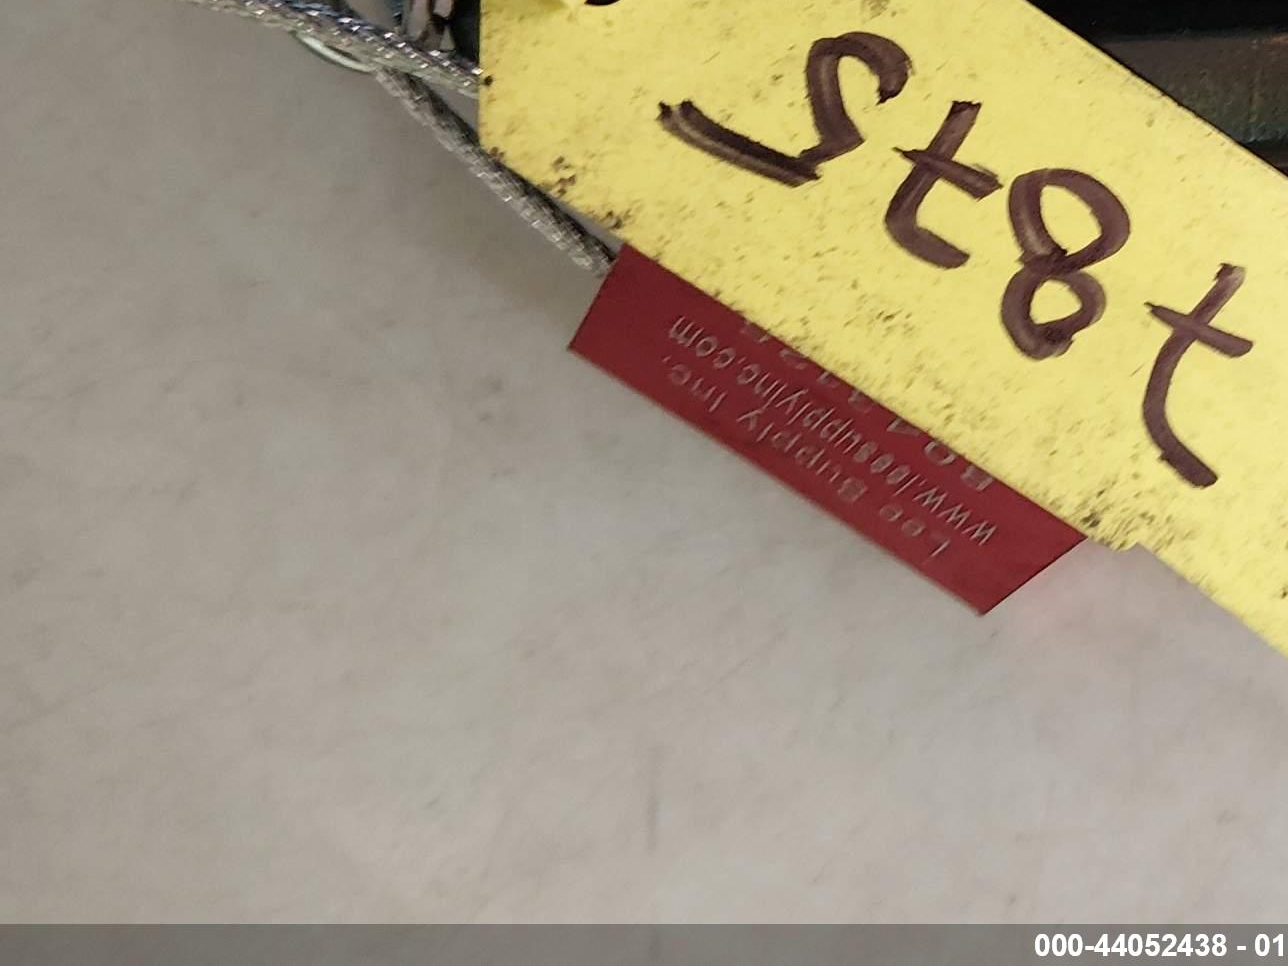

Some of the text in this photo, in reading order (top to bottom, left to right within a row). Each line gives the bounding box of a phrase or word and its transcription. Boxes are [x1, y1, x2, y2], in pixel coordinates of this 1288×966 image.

[657, 31, 1254, 489] 7875
[662, 356, 951, 559] Lee Supply Inc.
